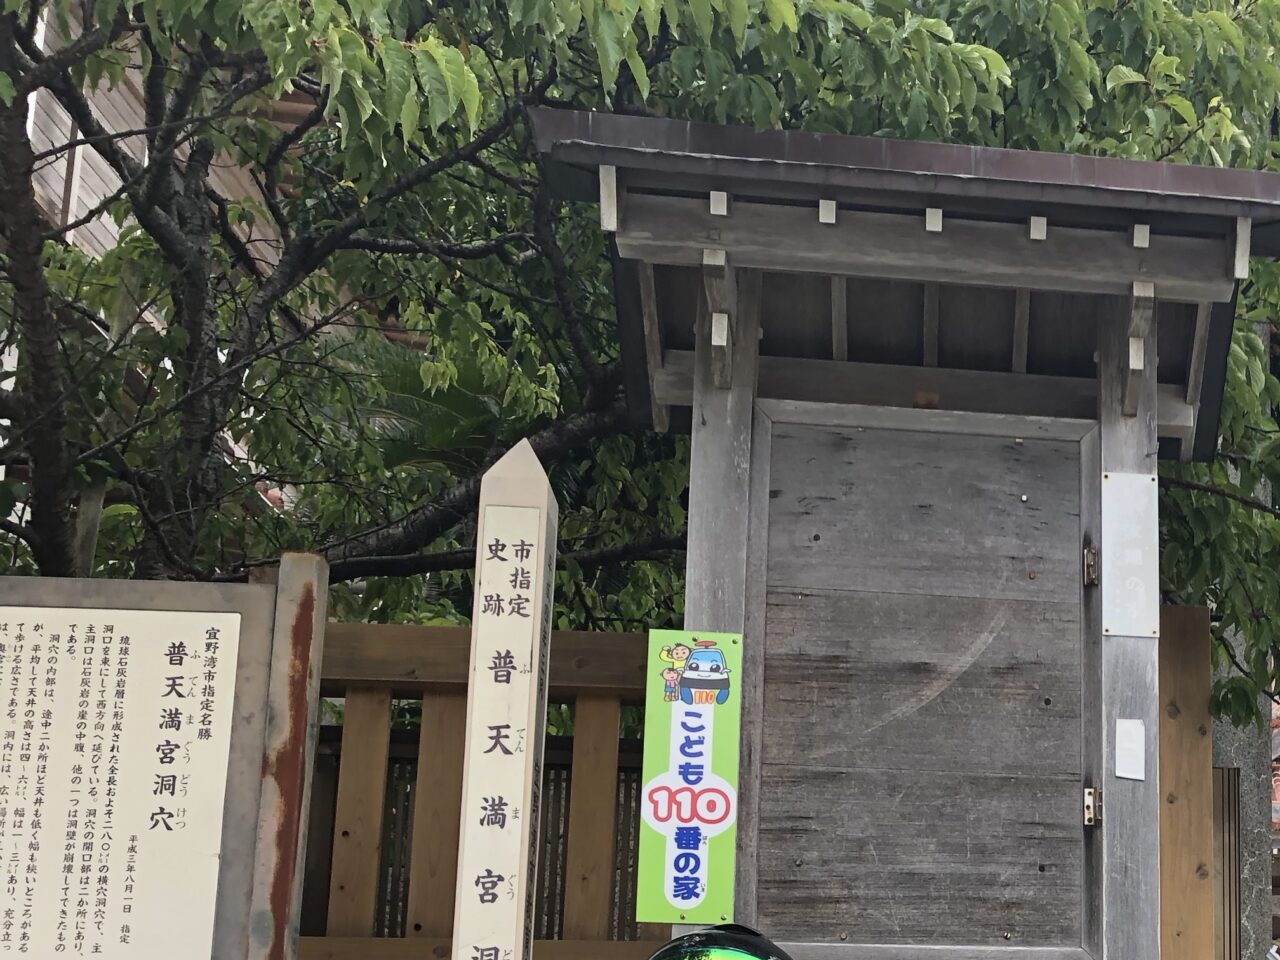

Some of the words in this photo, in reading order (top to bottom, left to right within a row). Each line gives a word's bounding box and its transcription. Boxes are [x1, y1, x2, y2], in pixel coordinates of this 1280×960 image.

[481, 537, 509, 617] 史跡
[508, 538, 534, 618] 市指定
[66, 623, 79, 661] である。
[196, 626, 221, 741] 宜野湾市指定名勝
[694, 690, 715, 704] 110
[148, 640, 189, 832] 普天満宮洞穴
[513, 728, 527, 753] てん
[122, 834, 139, 914] 平成三年八月一日
[119, 923, 131, 945] 指定
